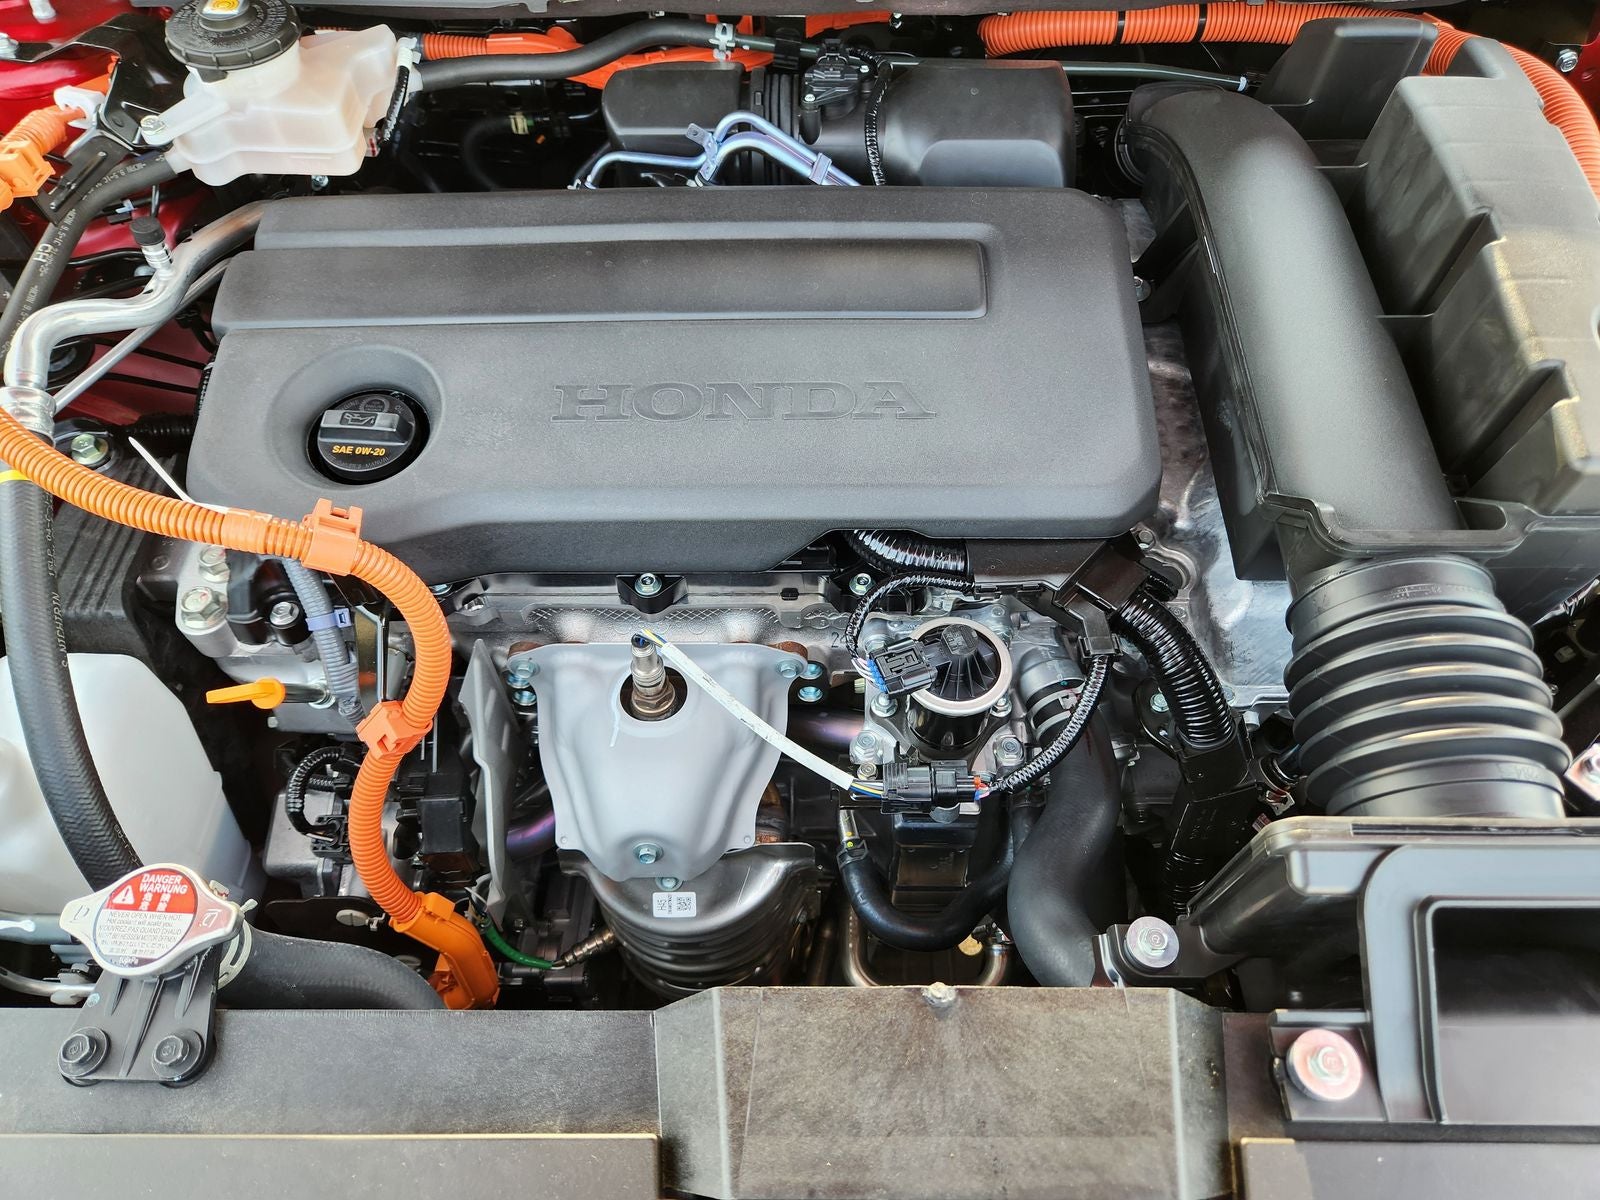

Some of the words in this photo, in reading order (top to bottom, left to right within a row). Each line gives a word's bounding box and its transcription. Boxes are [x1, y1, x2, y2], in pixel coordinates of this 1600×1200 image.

[32, 243, 54, 263] CH
[551, 381, 937, 422] HONDA
[332, 445, 354, 455] SAE
[355, 446, 386, 457] 0W-20
[51, 591, 68, 653] NICHIRIN
[142, 873, 182, 885] DANGER
[139, 882, 188, 895] WARNUNG
